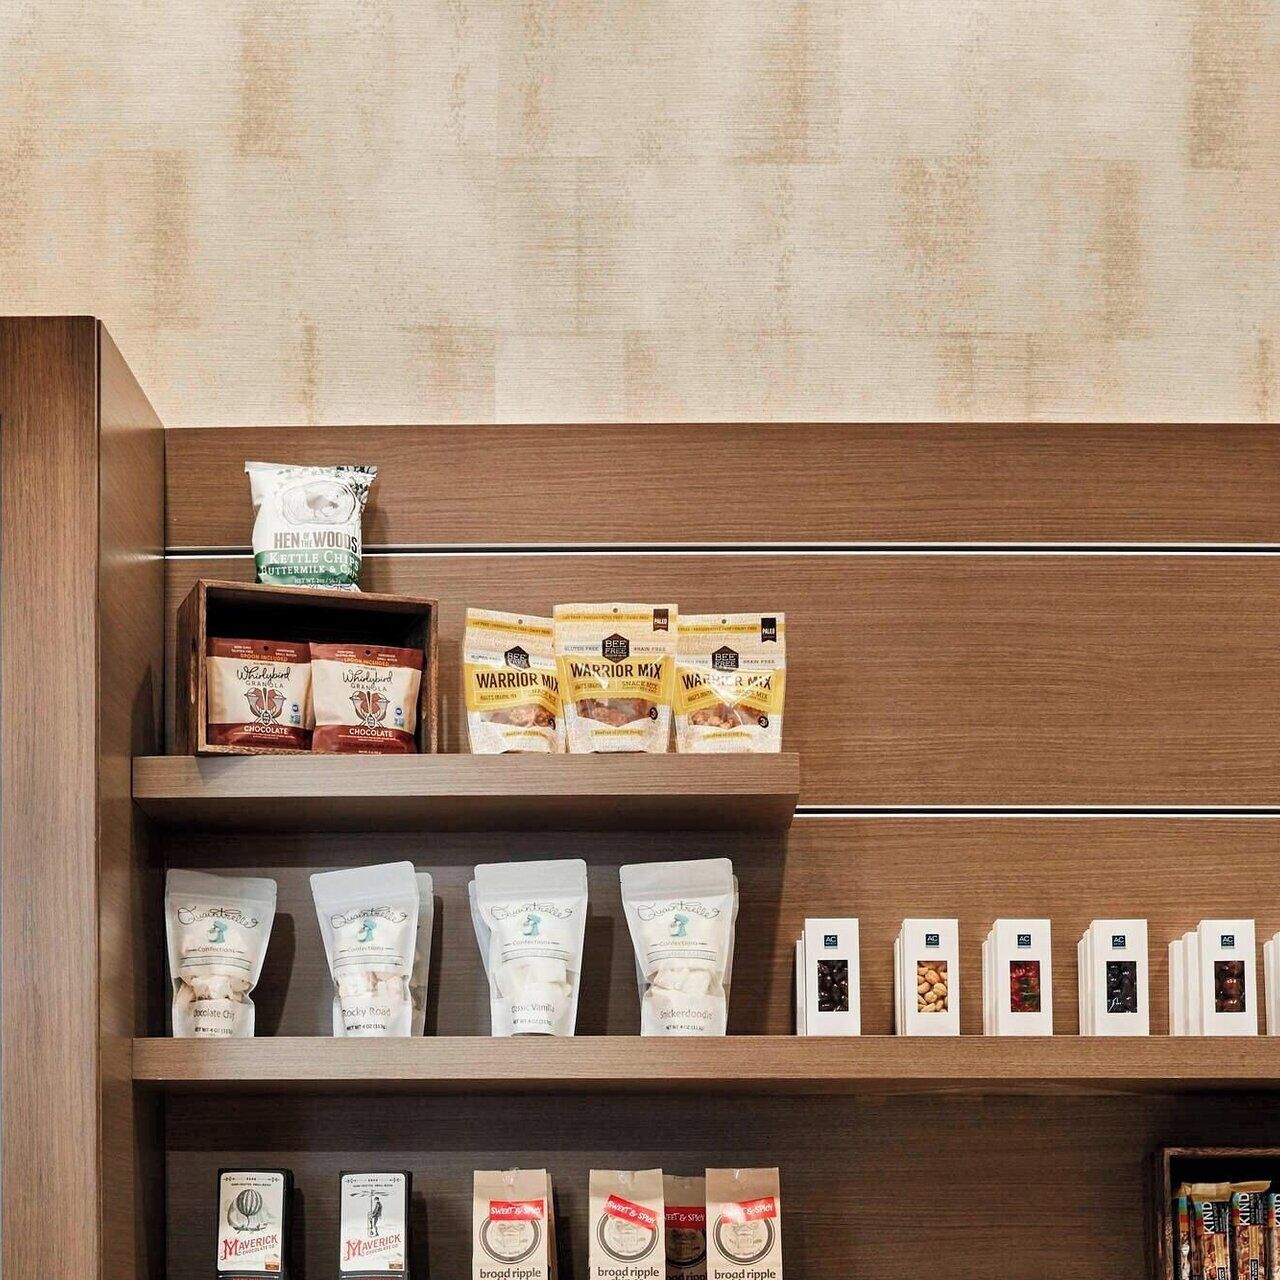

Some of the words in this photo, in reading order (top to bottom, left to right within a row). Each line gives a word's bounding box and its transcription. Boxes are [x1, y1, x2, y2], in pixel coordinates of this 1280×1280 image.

[274, 533, 299, 548] HEN
[313, 531, 358, 553] WOODS
[269, 552, 319, 563] KETTLE
[324, 550, 359, 571] CHIPS
[261, 566, 326, 575] BUTTERMILK
[605, 640, 627, 648] BEE
[508, 652, 526, 661] BEE
[237, 666, 291, 683] Whirlybird
[342, 669, 393, 684] Whirlybird
[571, 663, 633, 678] WARRIOR
[638, 663, 662, 679] MIX
[476, 673, 538, 688] WARRIOR
[541, 675, 559, 693] MIX
[244, 725, 288, 735] CHOCOLATE
[349, 728, 393, 737] CHOCOLATE
[342, 1006, 366, 1018] Rocky
[370, 1006, 391, 1017] Road
[659, 1009, 713, 1020] Snickerdoodle
[1239, 1193, 1250, 1226] KIND
[1203, 1202, 1214, 1234] KIND
[220, 1234, 278, 1262] MAVERICK
[343, 1234, 402, 1262] MAVERICK
[480, 1269, 510, 1279] broad
[512, 1268, 541, 1280] ripple
[598, 1267, 629, 1277] broad
[630, 1266, 659, 1278] ripple
[714, 1270, 745, 1280] broad
[746, 1269, 776, 1280] ripple
